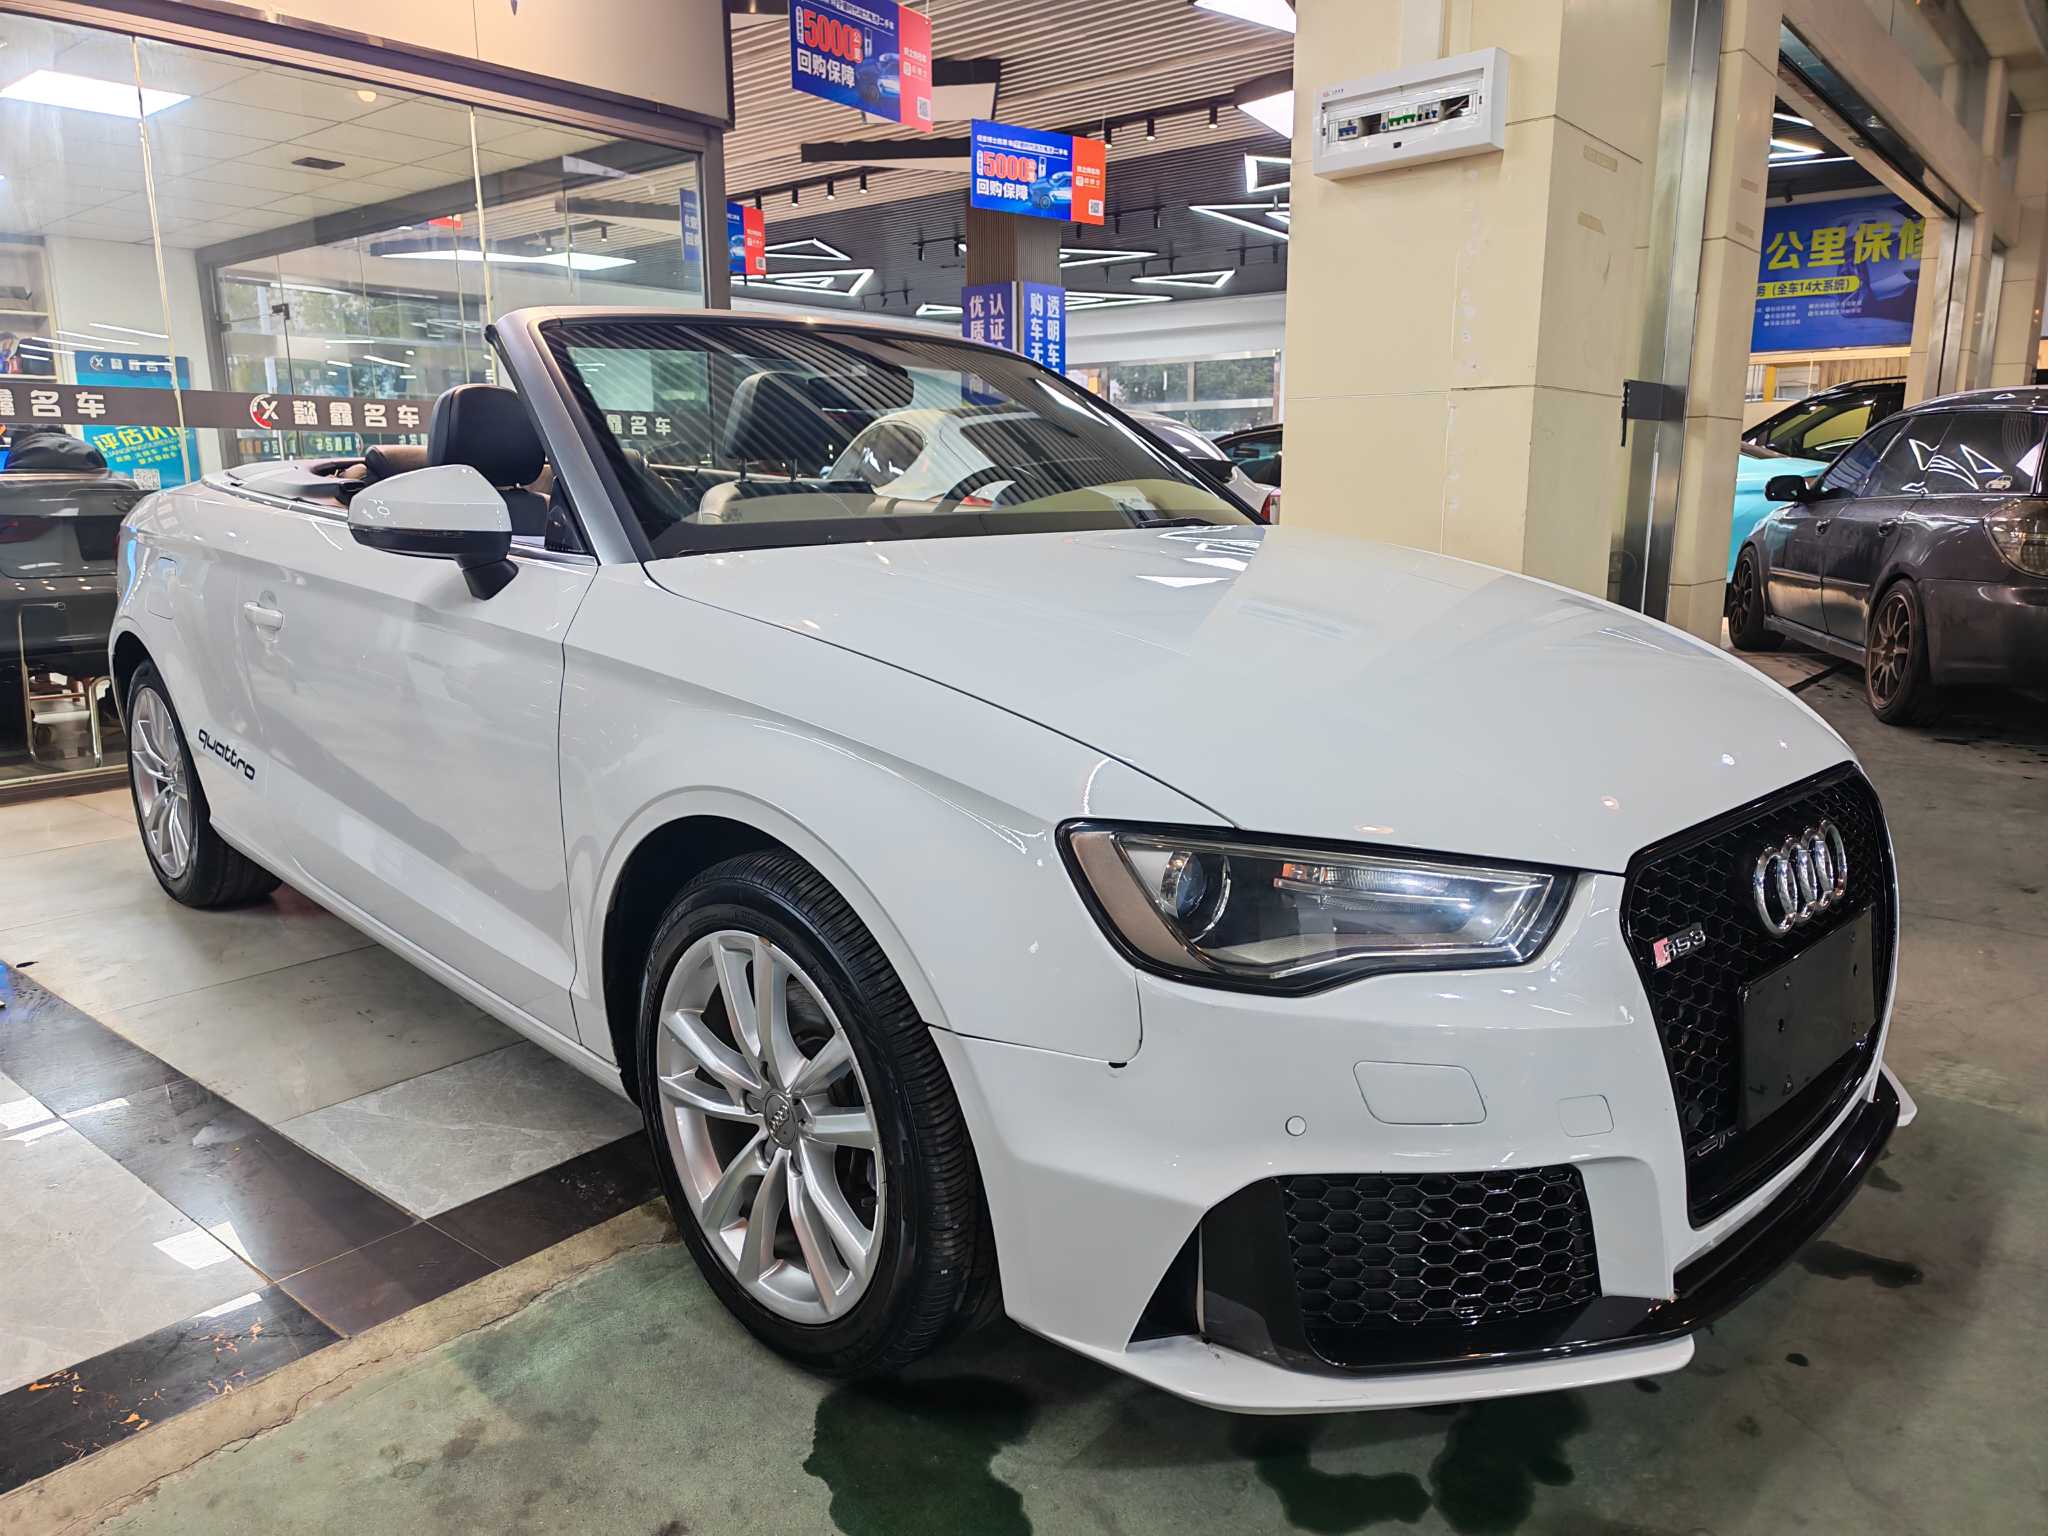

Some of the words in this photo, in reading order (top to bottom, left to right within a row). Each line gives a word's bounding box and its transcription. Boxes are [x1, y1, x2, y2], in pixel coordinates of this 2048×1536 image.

[797, 48, 855, 88] 回购保障
[976, 178, 1028, 200] 回购保障
[1766, 218, 1926, 270] 公里保修
[989, 293, 1005, 347] 认证
[1047, 294, 1060, 373] 透明车
[198, 728, 256, 780] quattro
[1662, 929, 1706, 960] RS3
